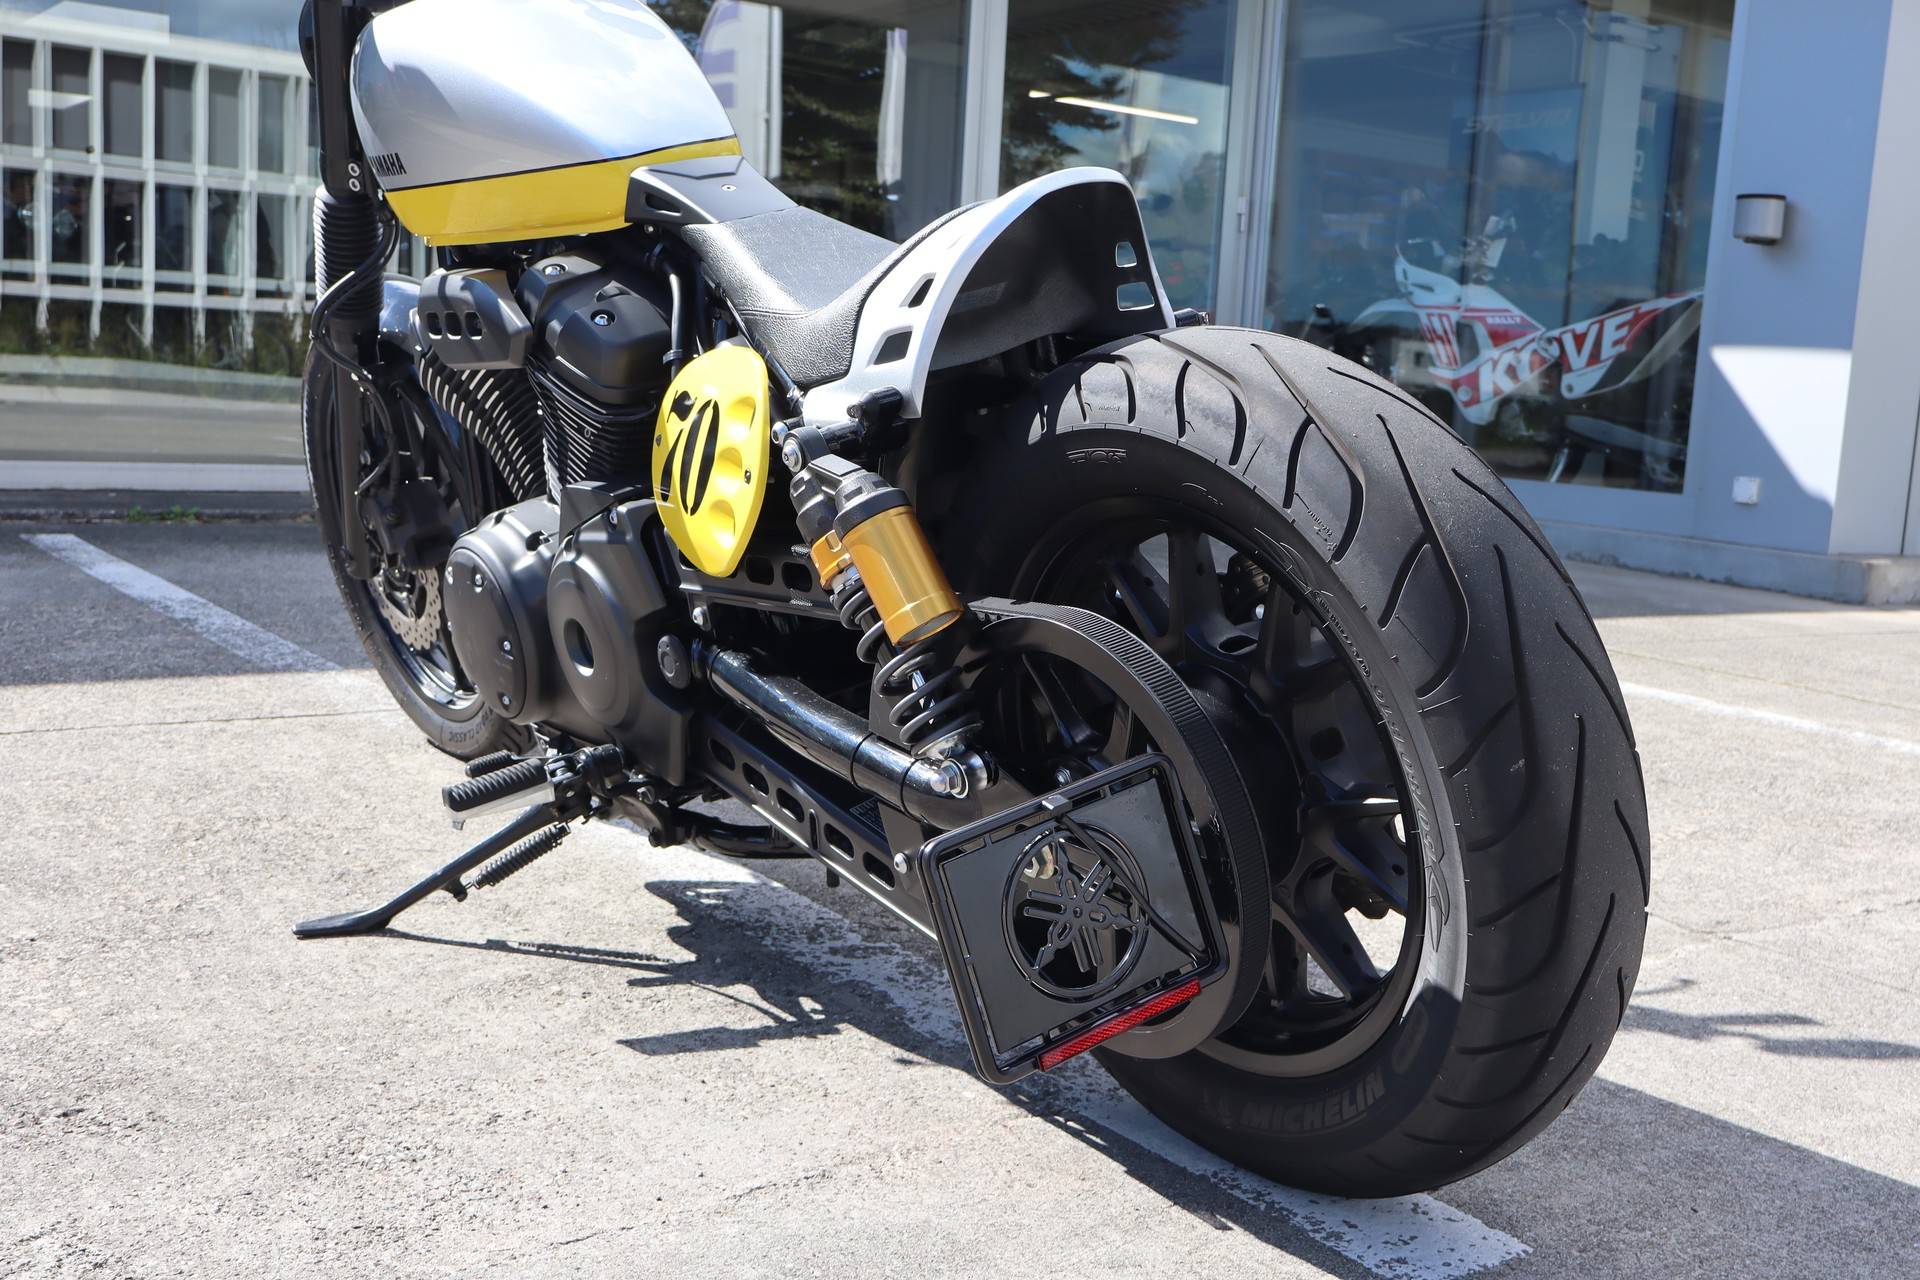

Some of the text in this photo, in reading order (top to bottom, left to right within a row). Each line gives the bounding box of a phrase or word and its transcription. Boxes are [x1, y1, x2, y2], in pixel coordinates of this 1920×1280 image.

[1462, 108, 1572, 134] STELVIO
[368, 152, 407, 177] AMAHA
[1486, 316, 1521, 325] RALLY
[1478, 311, 1636, 400] KOVE
[660, 390, 720, 516] 70
[448, 728, 475, 742] CLASSIC
[1240, 1063, 1386, 1132] MICHELIN
